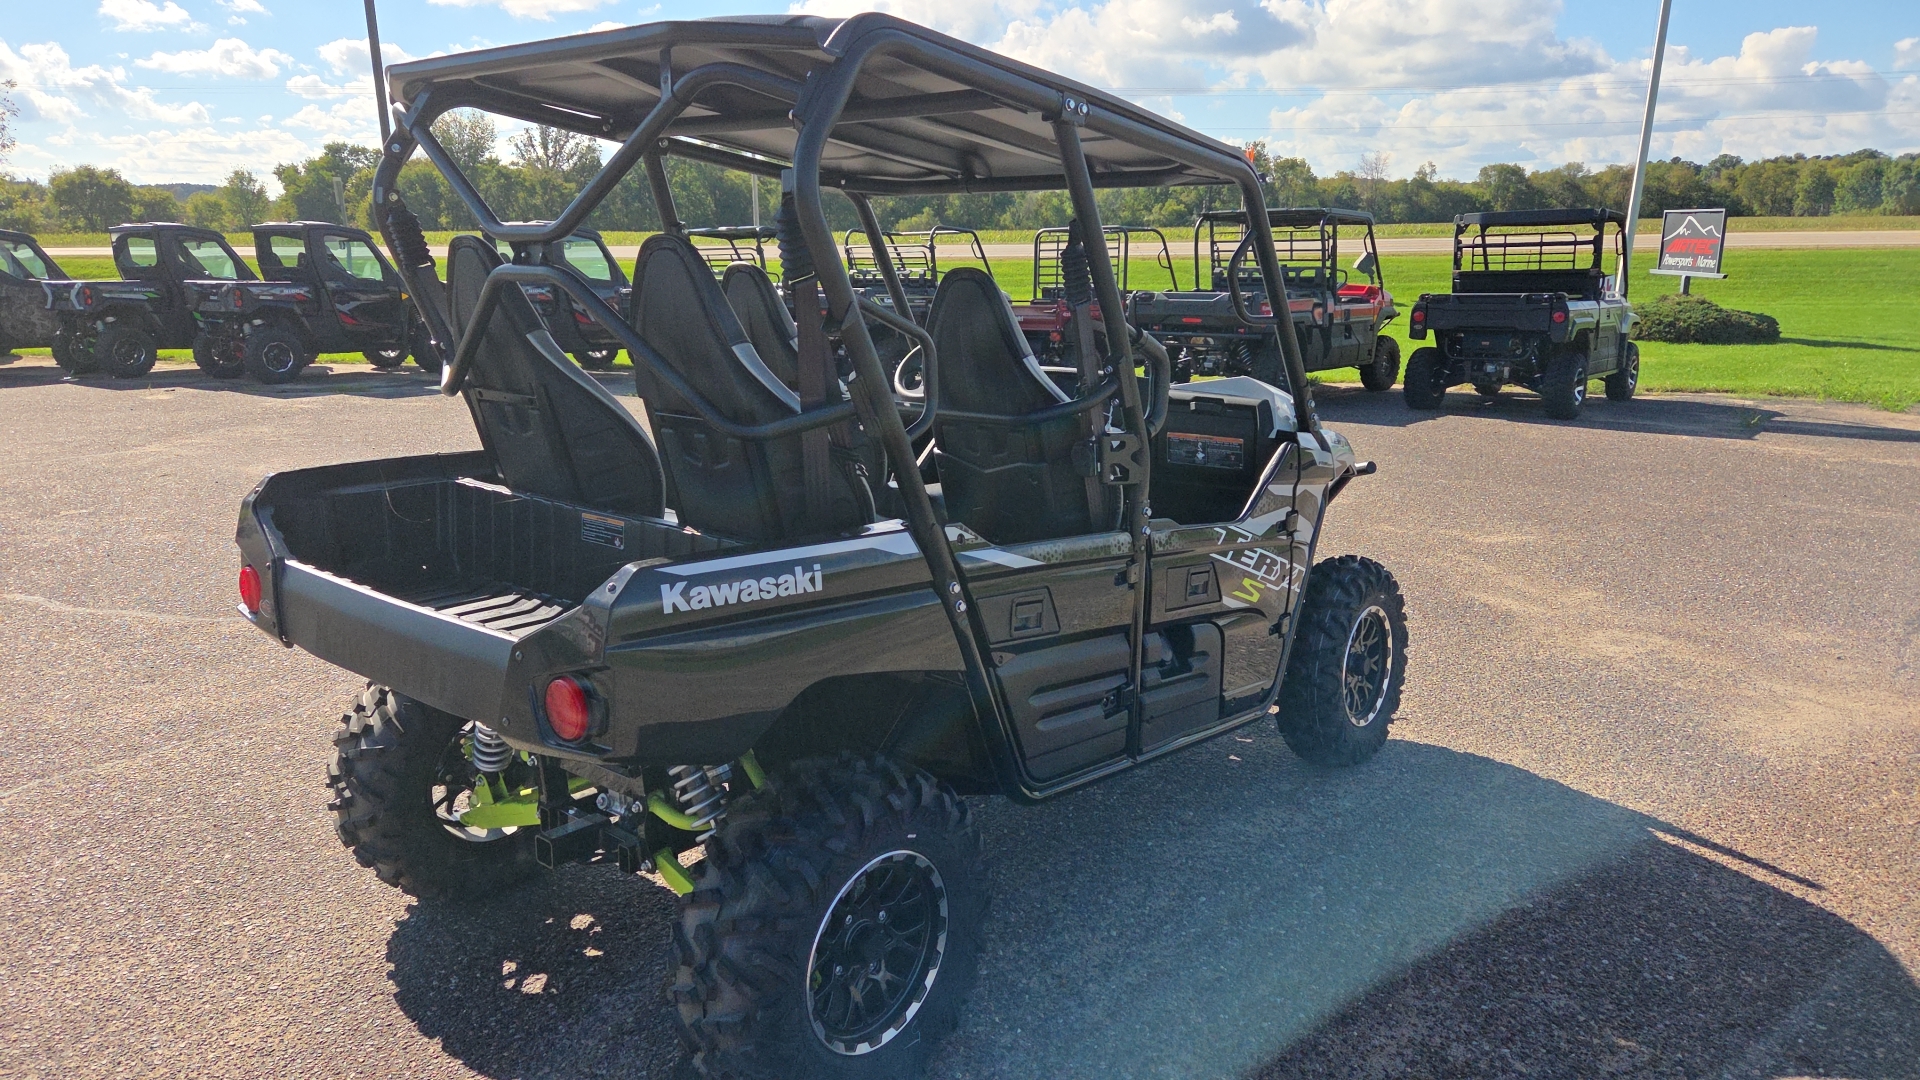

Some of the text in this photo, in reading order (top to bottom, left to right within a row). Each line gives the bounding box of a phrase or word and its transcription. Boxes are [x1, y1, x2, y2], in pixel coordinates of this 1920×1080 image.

[1662, 254, 1717, 268] Powersports Marine
[660, 563, 823, 615] Kawasaki
